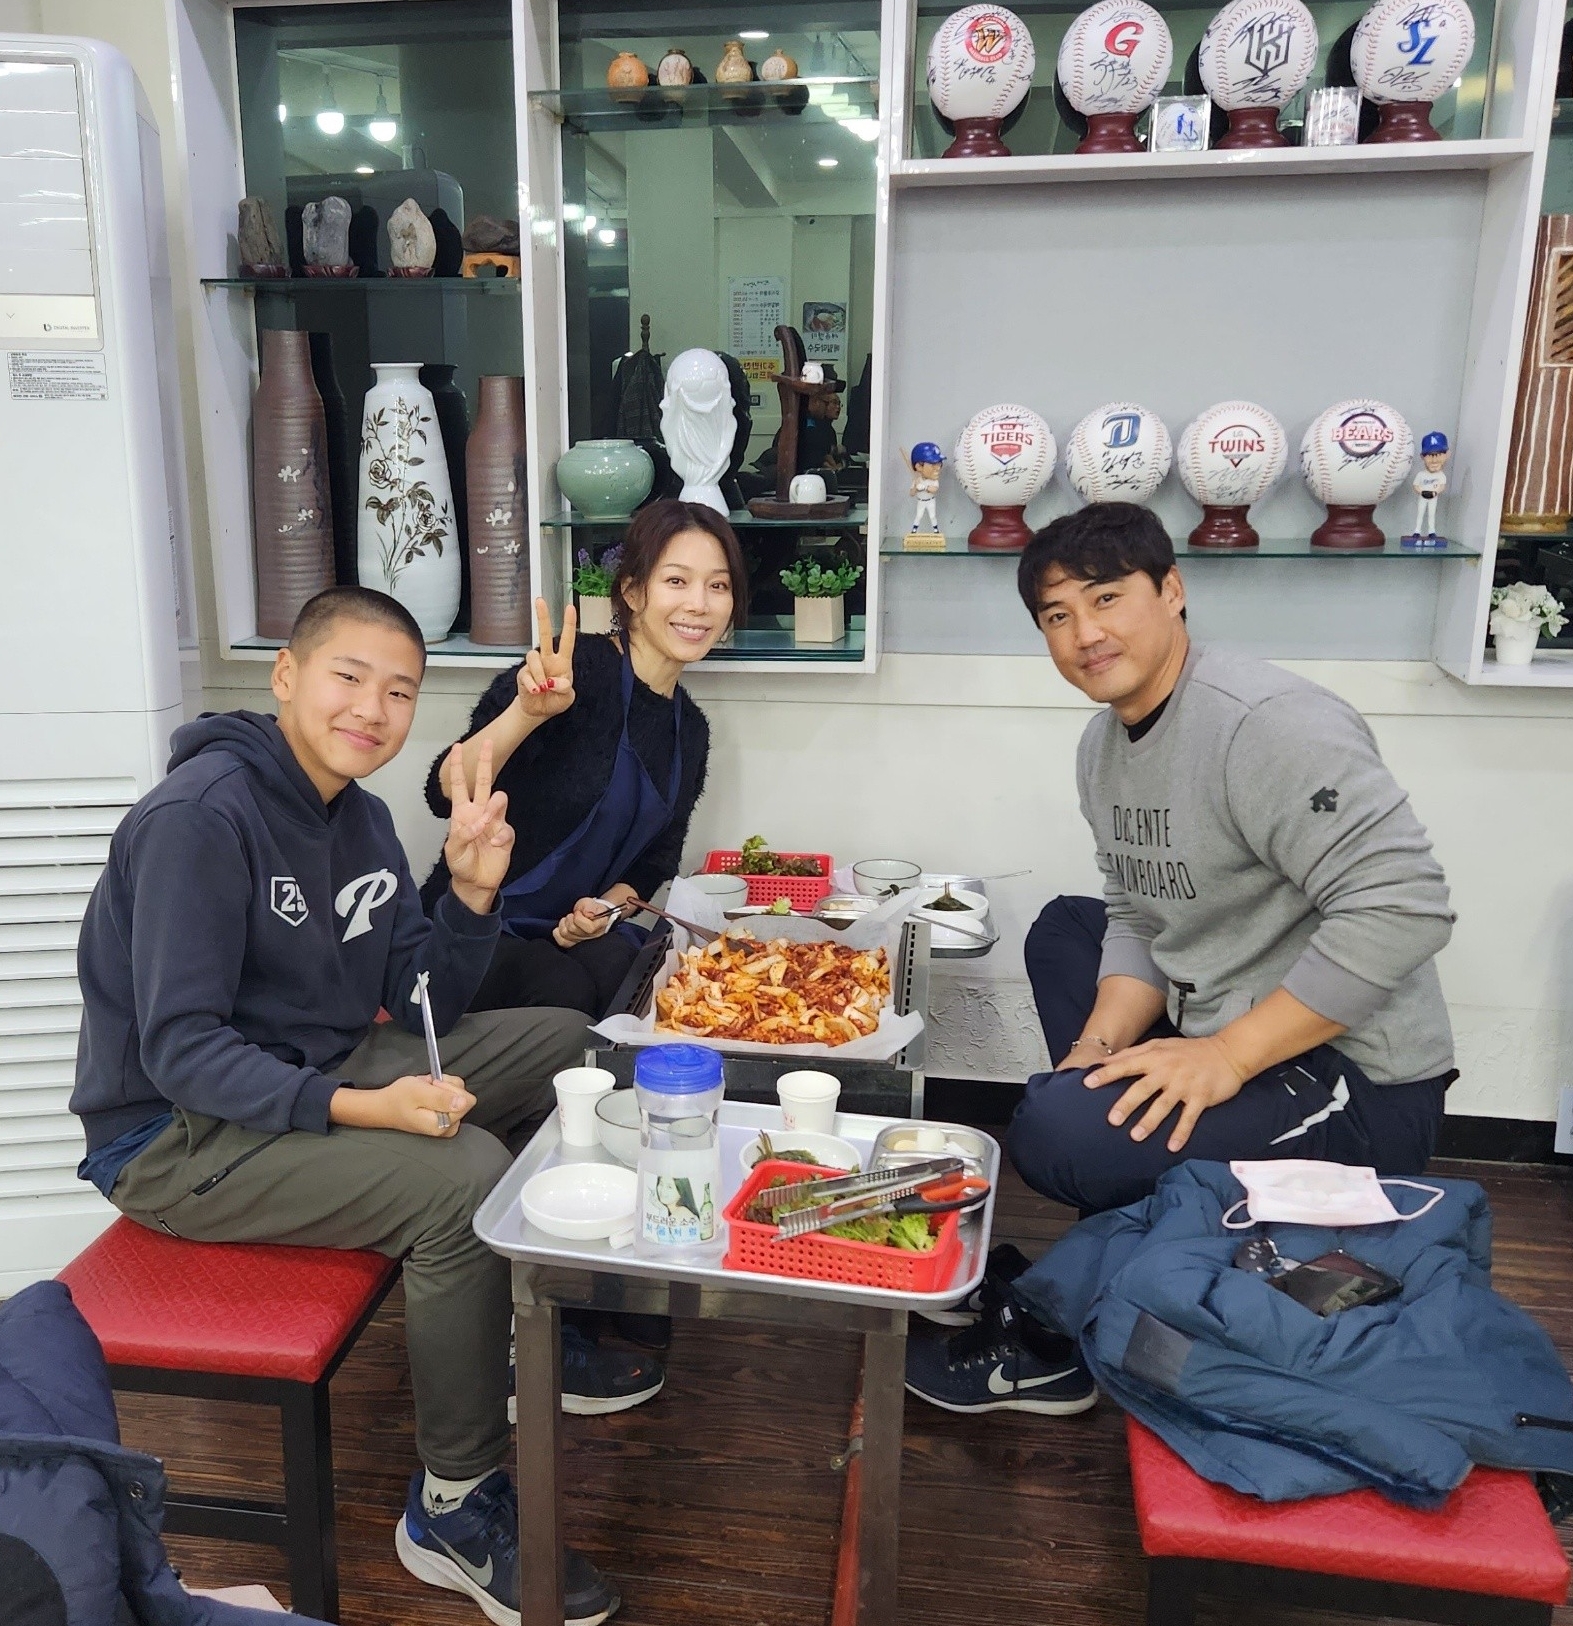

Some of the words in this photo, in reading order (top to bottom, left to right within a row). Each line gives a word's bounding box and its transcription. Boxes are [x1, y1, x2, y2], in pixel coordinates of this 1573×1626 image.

[1104, 21, 1144, 58] G
[981, 432, 1034, 446] TIGERS
[1332, 426, 1394, 442] BEARS
[1209, 439, 1266, 453] TWINS
[334, 868, 398, 943] P
